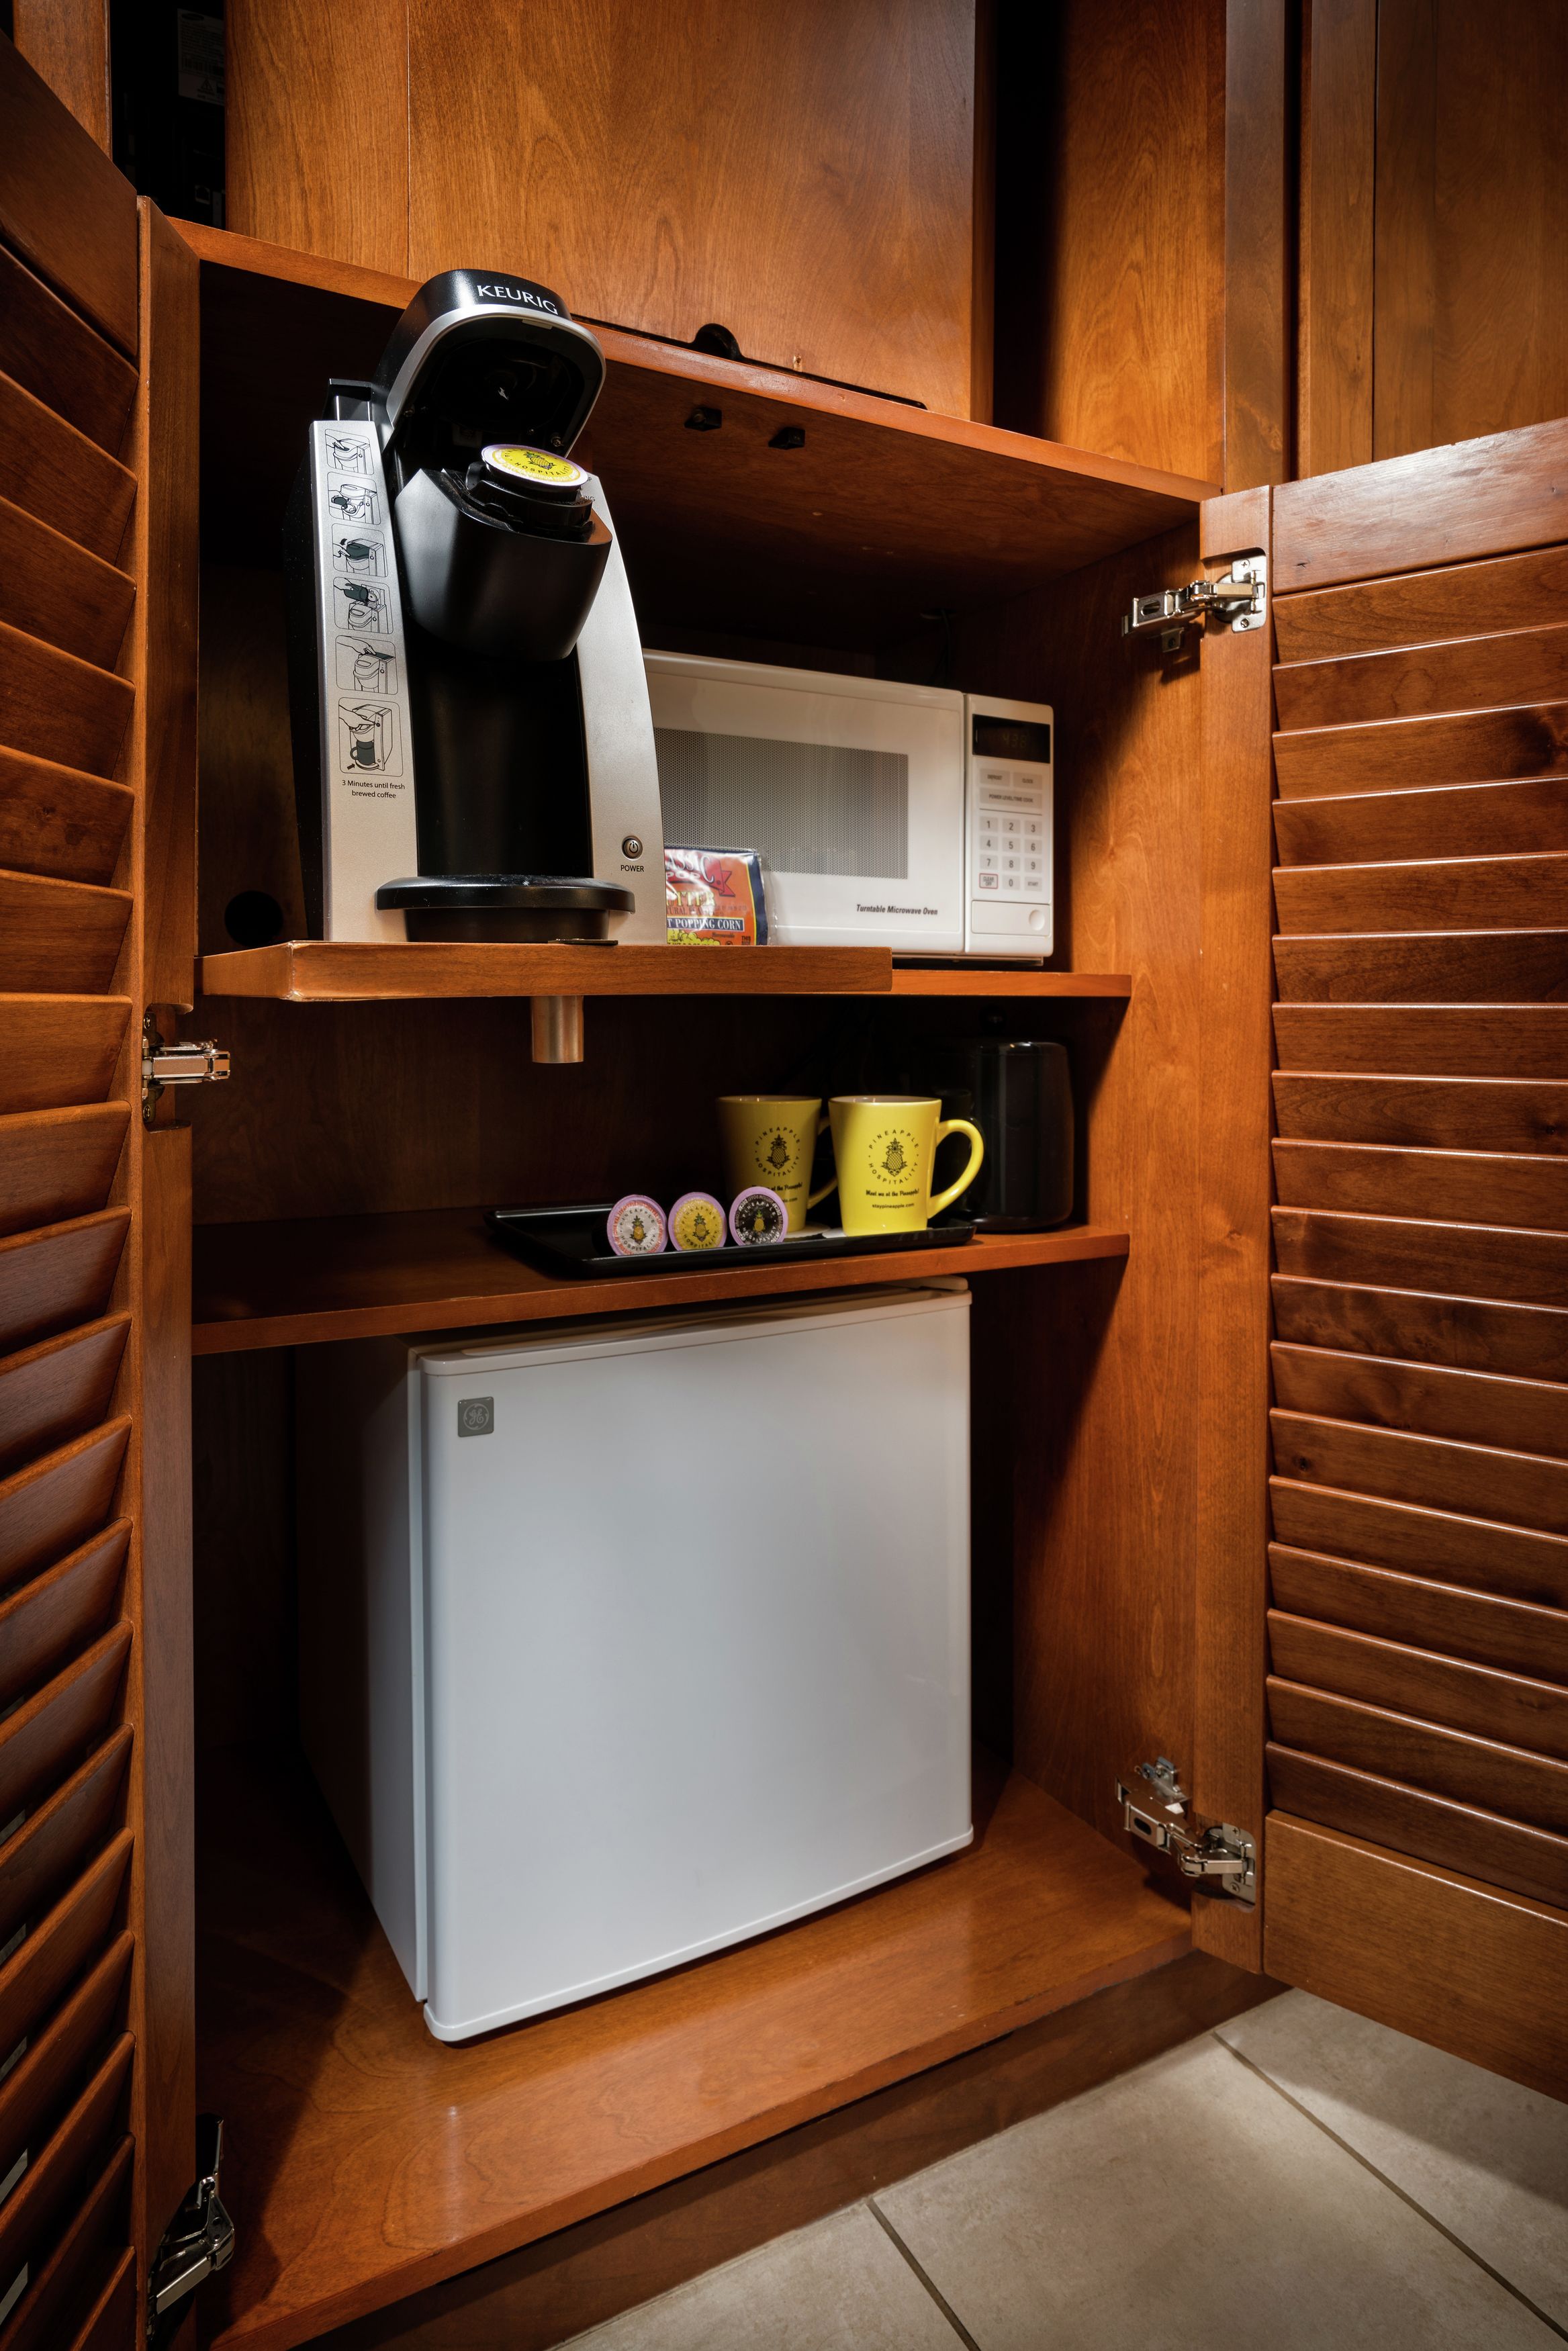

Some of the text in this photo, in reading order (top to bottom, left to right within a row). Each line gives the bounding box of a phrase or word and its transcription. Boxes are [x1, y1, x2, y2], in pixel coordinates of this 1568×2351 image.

[477, 285, 559, 315] KEURIG
[987, 821, 990, 829] 1
[1009, 823, 1014, 831] 2
[1031, 825, 1035, 833] 3
[986, 839, 991, 847] 4
[1009, 841, 1013, 849] 5
[1031, 843, 1035, 851] 6
[986, 858, 991, 866] 7
[1009, 860, 1014, 868] 8
[1031, 862, 1035, 870] 9
[1009, 878, 1013, 886] 0
[857, 904, 938, 915] Turntable Microwave Oven
[676, 918, 715, 929] POPPING
[717, 919, 741, 930] CORN
[755, 1127, 800, 1145] PINEAPPLE
[868, 1129, 919, 1149] PINEAPPLE
[755, 1157, 799, 1177] HOSPITALITY
[869, 1162, 918, 1185] HOSPITALITY
[743, 1201, 776, 1217] PINEAPPLE
[620, 1209, 655, 1226] PINEAPPLE
[743, 1226, 776, 1244] HOSPITALITY
[620, 1235, 656, 1251] HOSPITALITY
